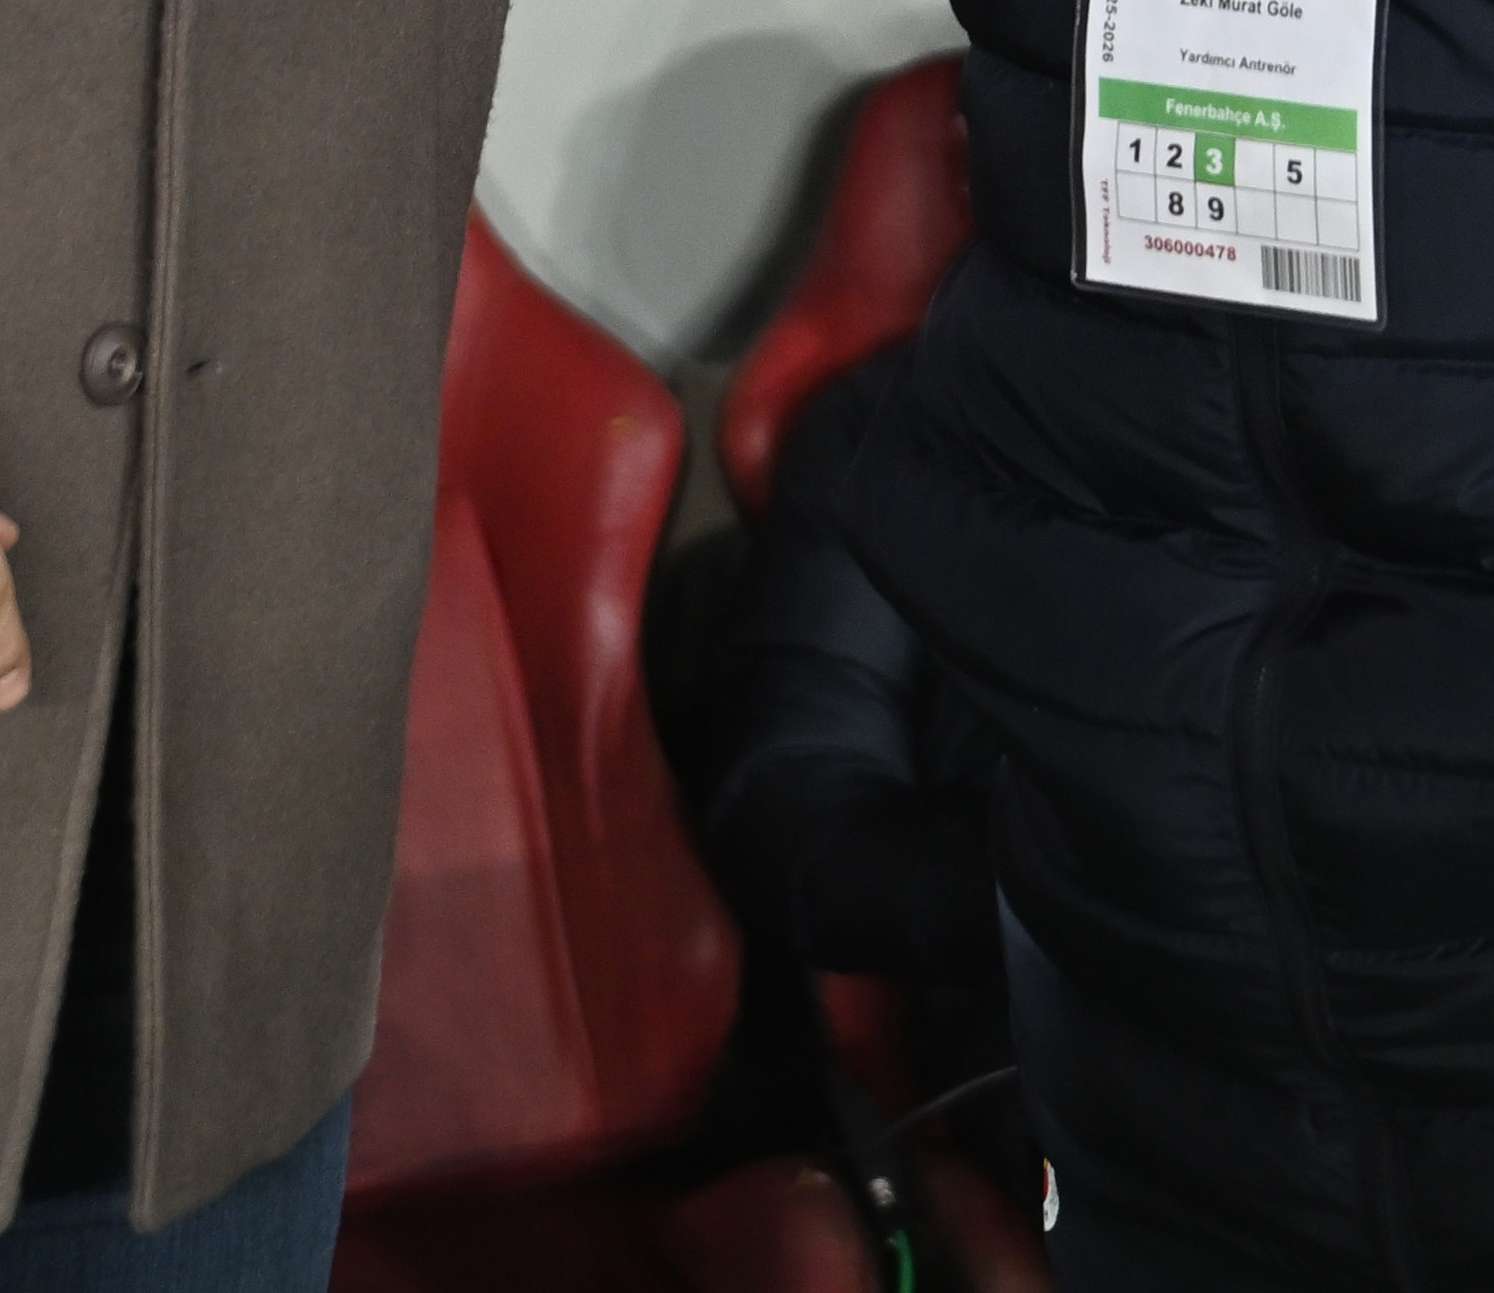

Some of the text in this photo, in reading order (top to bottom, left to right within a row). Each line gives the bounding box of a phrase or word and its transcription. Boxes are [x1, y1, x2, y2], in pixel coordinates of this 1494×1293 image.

[1267, 0, 1303, 19] Göle
[1179, 48, 1297, 76] Yardımcı Antrenör
[1166, 98, 1286, 132] Fenerbahçe A.Ş.
[1129, 138, 1303, 184] 1 2 3 5
[1168, 191, 1225, 221] 8 9
[1144, 234, 1237, 262] 306000478
